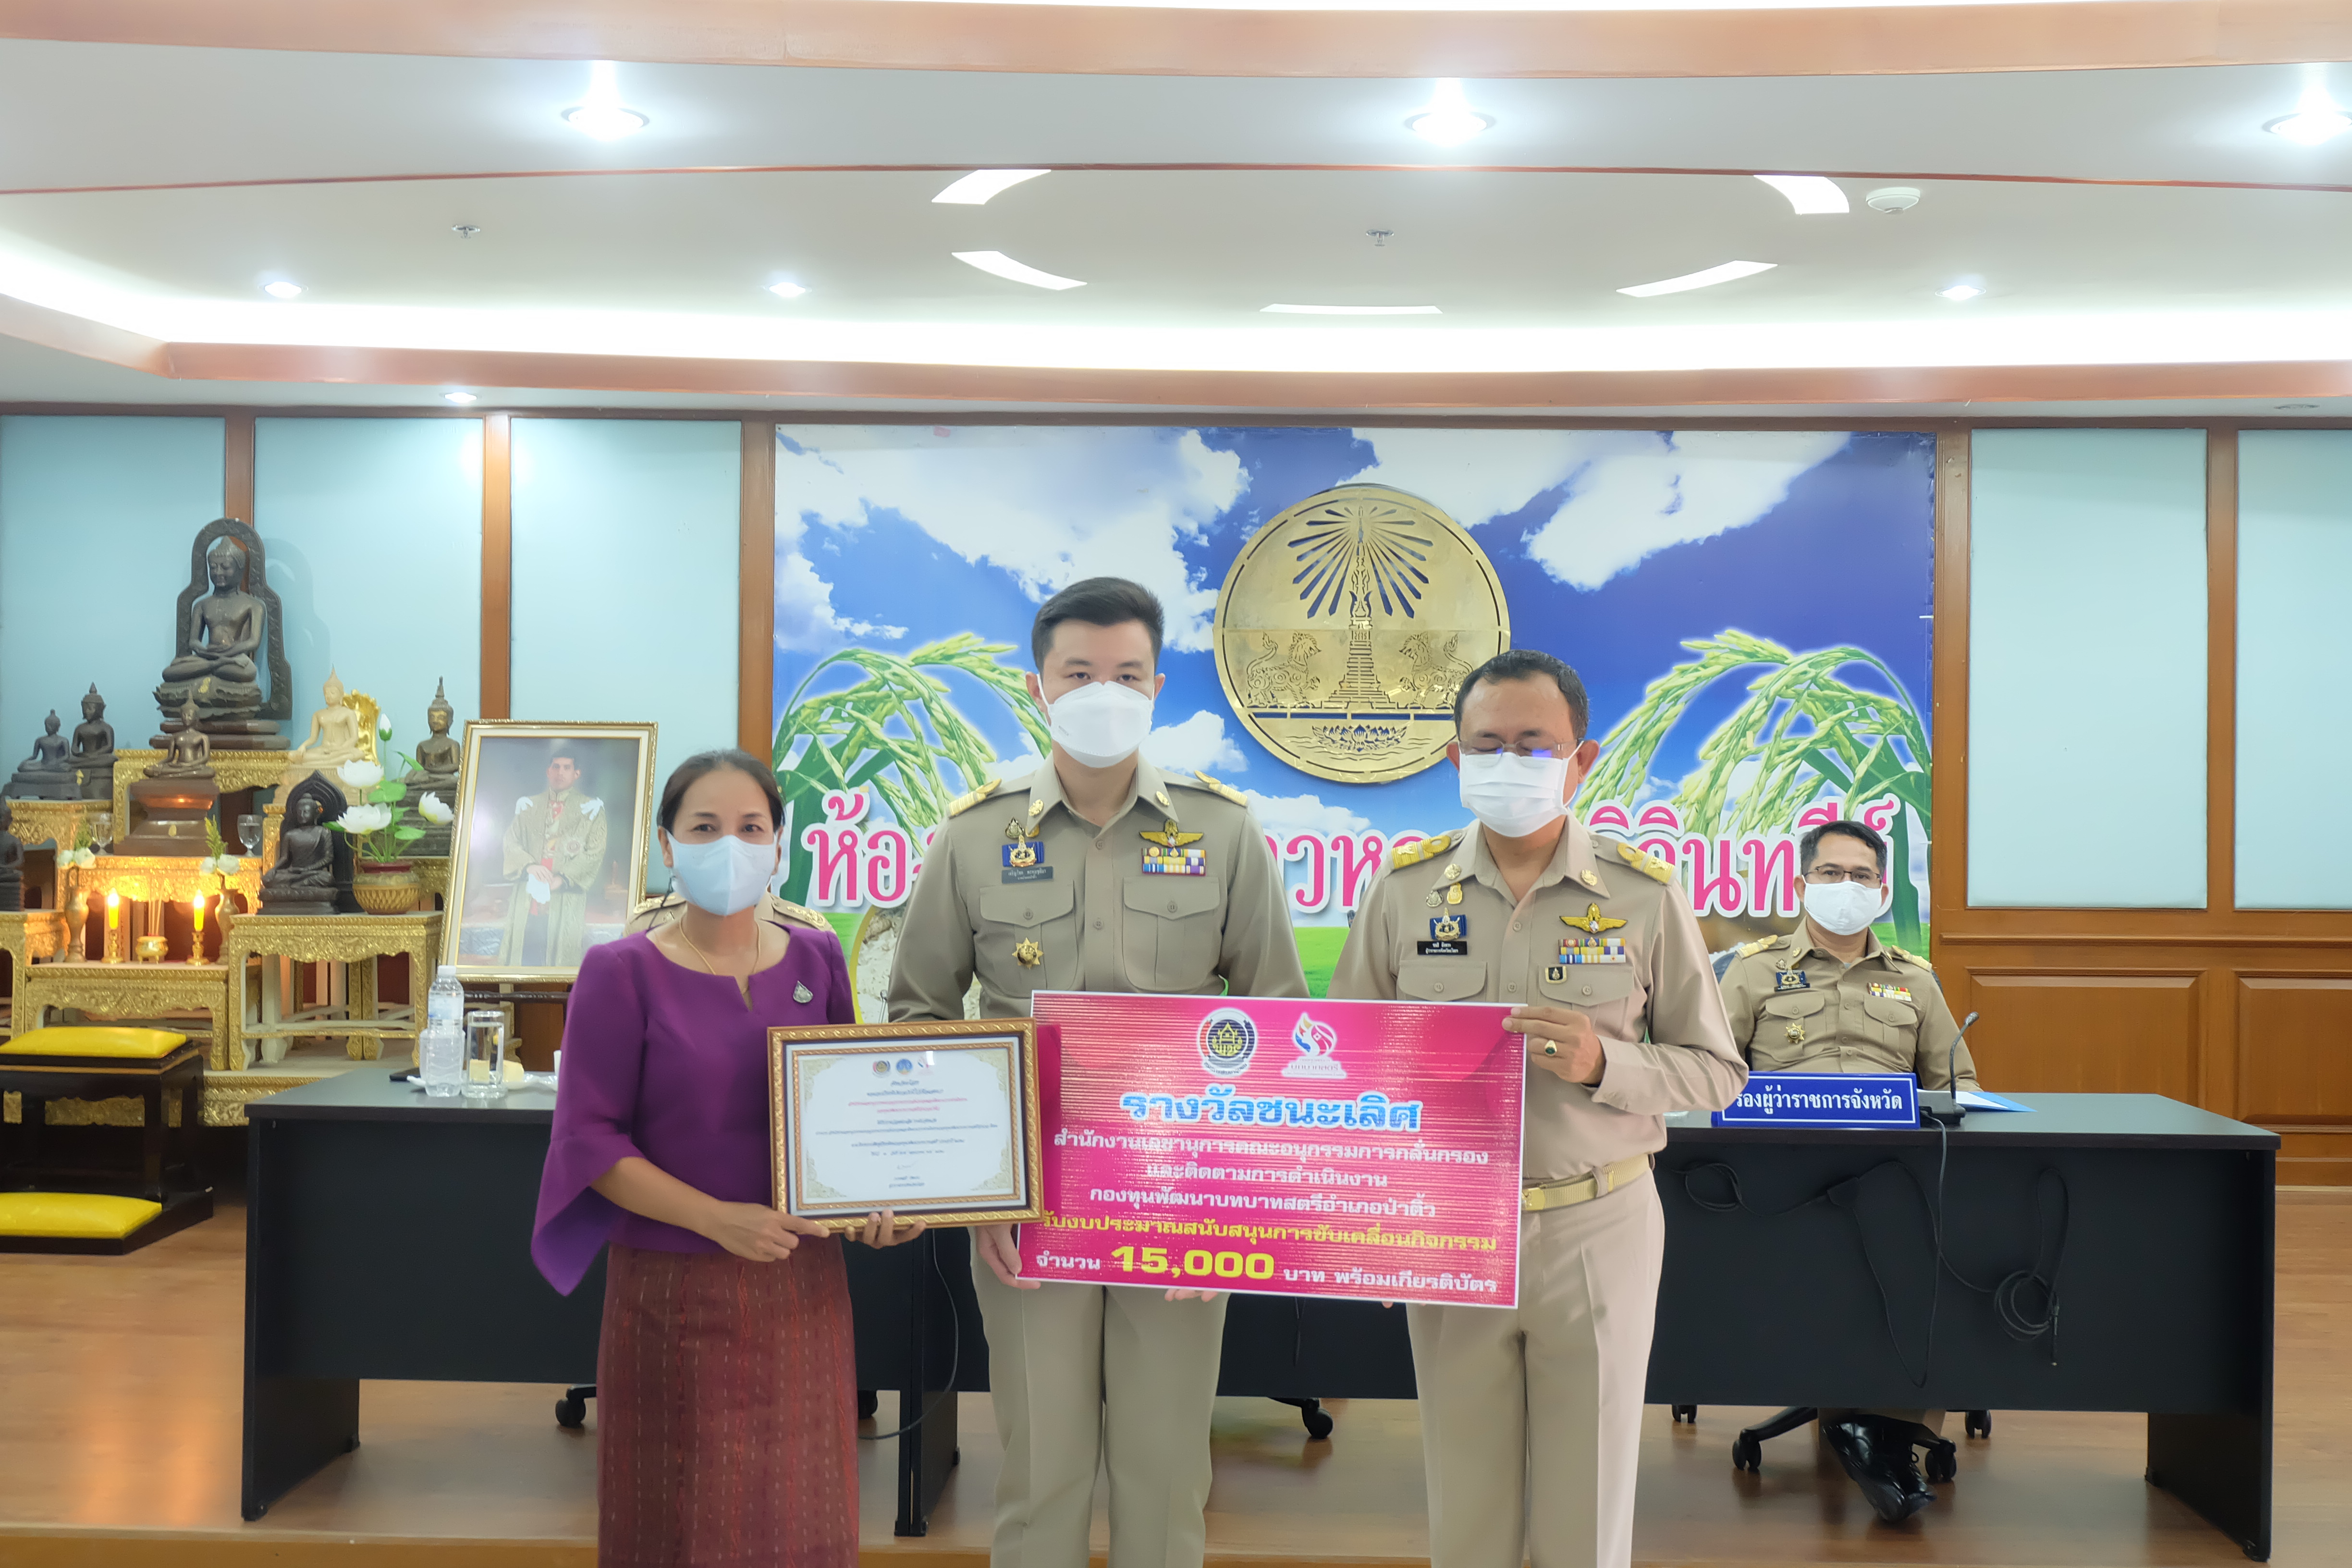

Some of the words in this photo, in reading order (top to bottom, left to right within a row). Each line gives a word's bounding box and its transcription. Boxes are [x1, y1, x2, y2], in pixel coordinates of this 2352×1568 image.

[1122, 1085, 1421, 1130] รางวัลชนะเลิศ
[1736, 1085, 1902, 1114] รองผู้ว่าราชการจังหวัด
[1054, 1128, 1488, 1164] สำนักงานเลขานุการคณะอนุกรรมการกลั่นกรอง
[1147, 1161, 1388, 1187] และติดตามการดำเนินงาน
[1090, 1186, 1435, 1217] กองทุนพัฒนาบทบาทสตรีอำเภอป่าติ้ว
[1044, 1210, 1496, 1250] รับงบประมาณสนับสนุนการขับเคลื่อนกิจกรรม
[1036, 1250, 1101, 1270] จำนวน
[1111, 1246, 1274, 1279] 15,000
[1284, 1268, 1325, 1282] บาท
[1334, 1266, 1497, 1292] พร้อมเกียรติบัตร
